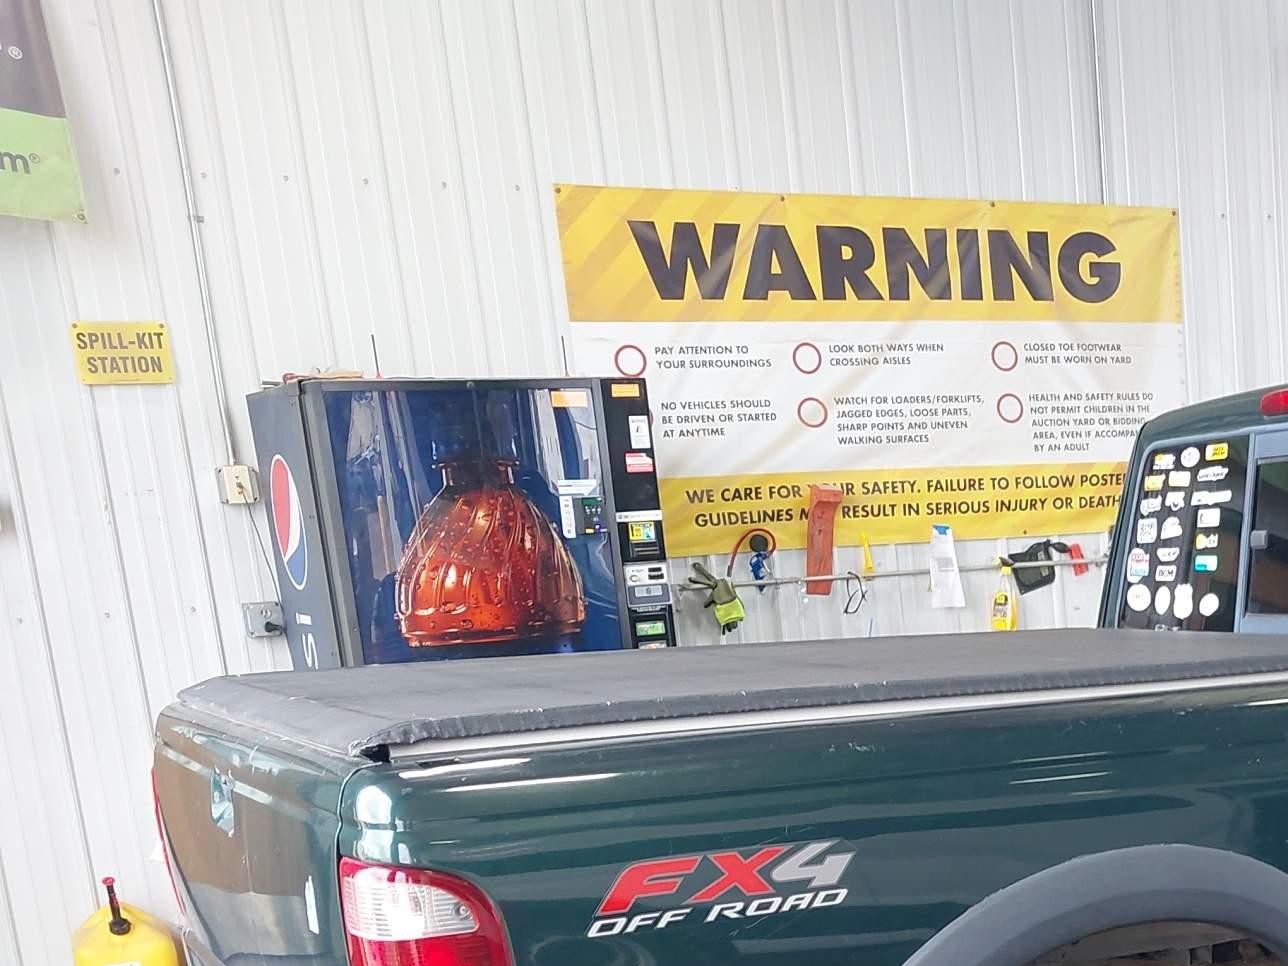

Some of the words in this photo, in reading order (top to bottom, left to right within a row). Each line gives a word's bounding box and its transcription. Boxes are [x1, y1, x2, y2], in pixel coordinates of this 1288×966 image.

[626, 219, 1121, 304] WARNING
[76, 332, 164, 350] SPILL-KIT
[654, 346, 674, 355] PAY
[679, 346, 733, 354] ATTENTION
[736, 345, 749, 354] TO
[828, 344, 855, 353] LOOK
[858, 344, 883, 353] BOTH
[886, 343, 914, 352] WAYS
[916, 343, 944, 352] WHEN
[1023, 343, 1056, 351] CLOSED
[1058, 343, 1075, 351] TOE
[1077, 343, 1122, 352] FOOTWEAR
[87, 356, 164, 374] STATION
[656, 360, 686, 369] YOUR
[689, 359, 772, 368] SURROUNDINGS
[829, 357, 879, 367] CROSSING
[882, 356, 911, 365] AISLES
[1025, 356, 1048, 364] MUST
[1051, 356, 1061, 364] BE
[1064, 356, 1092, 364] WORN
[1094, 356, 1107, 364] ON
[1110, 356, 1132, 364] YARD
[833, 396, 867, 405] WATCH
[870, 396, 889, 405] FOR
[891, 394, 985, 405] LOADERS/FORKLIFTS,
[1028, 393, 1060, 402] HEALTH
[1063, 393, 1083, 401] AND
[1085, 393, 1114, 401] SAFETY
[1116, 392, 1140, 401] RULES
[1142, 392, 1153, 400] DO
[661, 402, 677, 410] NO
[680, 400, 727, 410] VEHICLES
[730, 399, 771, 409] SHOULD
[1030, 406, 1048, 415] NOT
[1051, 405, 1080, 414] PERMIT
[1083, 405, 1123, 414] CHILDREN
[1126, 405, 1134, 413] IN
[1137, 405, 1150, 413] THE
[662, 415, 673, 424] BE
[676, 414, 715, 424] DRIVEN
[719, 414, 734, 422] OR
[737, 413, 777, 422] STARTED
[836, 410, 872, 419] JAGGED
[875, 409, 907, 418] EDGES,
[909, 408, 939, 417] LOOSE
[941, 407, 972, 417] PARTS,
[837, 422, 868, 432] SHARP
[871, 422, 905, 431] POINTS
[907, 421, 928, 430] AND
[930, 420, 968, 429] UNEVEN
[1031, 418, 1070, 427] AUCTION
[1073, 418, 1095, 426] YARD
[663, 429, 674, 438] AT
[678, 427, 726, 437] ANYTIME
[1033, 431, 1058, 440] AREA,
[1060, 430, 1082, 439] EVEN
[1085, 430, 1092, 438] IF
[1094, 430, 1138, 438] ACCOMPA
[837, 435, 883, 445] WALKING
[886, 434, 929, 444] SURFACES
[1034, 444, 1044, 452] BY
[1047, 443, 1061, 451] AN
[1064, 443, 1089, 451] ADULT
[686, 489, 715, 503] WE
[720, 486, 762, 502] CARE
[768, 484, 803, 500] FOR
[861, 480, 921, 495] SAFETY.
[927, 477, 985, 493] FAILURE
[989, 477, 1010, 490] TO
[1015, 474, 1076, 490] FOLLOW
[695, 508, 794, 528] GUIDELINES
[841, 503, 897, 520] RESULT
[903, 502, 920, 517] IN
[926, 500, 990, 516] SERIOUS
[995, 497, 1047, 513] INJURY
[1052, 497, 1073, 510] OR
[596, 839, 856, 916] FX4
[587, 907, 692, 938] OFF
[704, 888, 848, 923] ROAD
